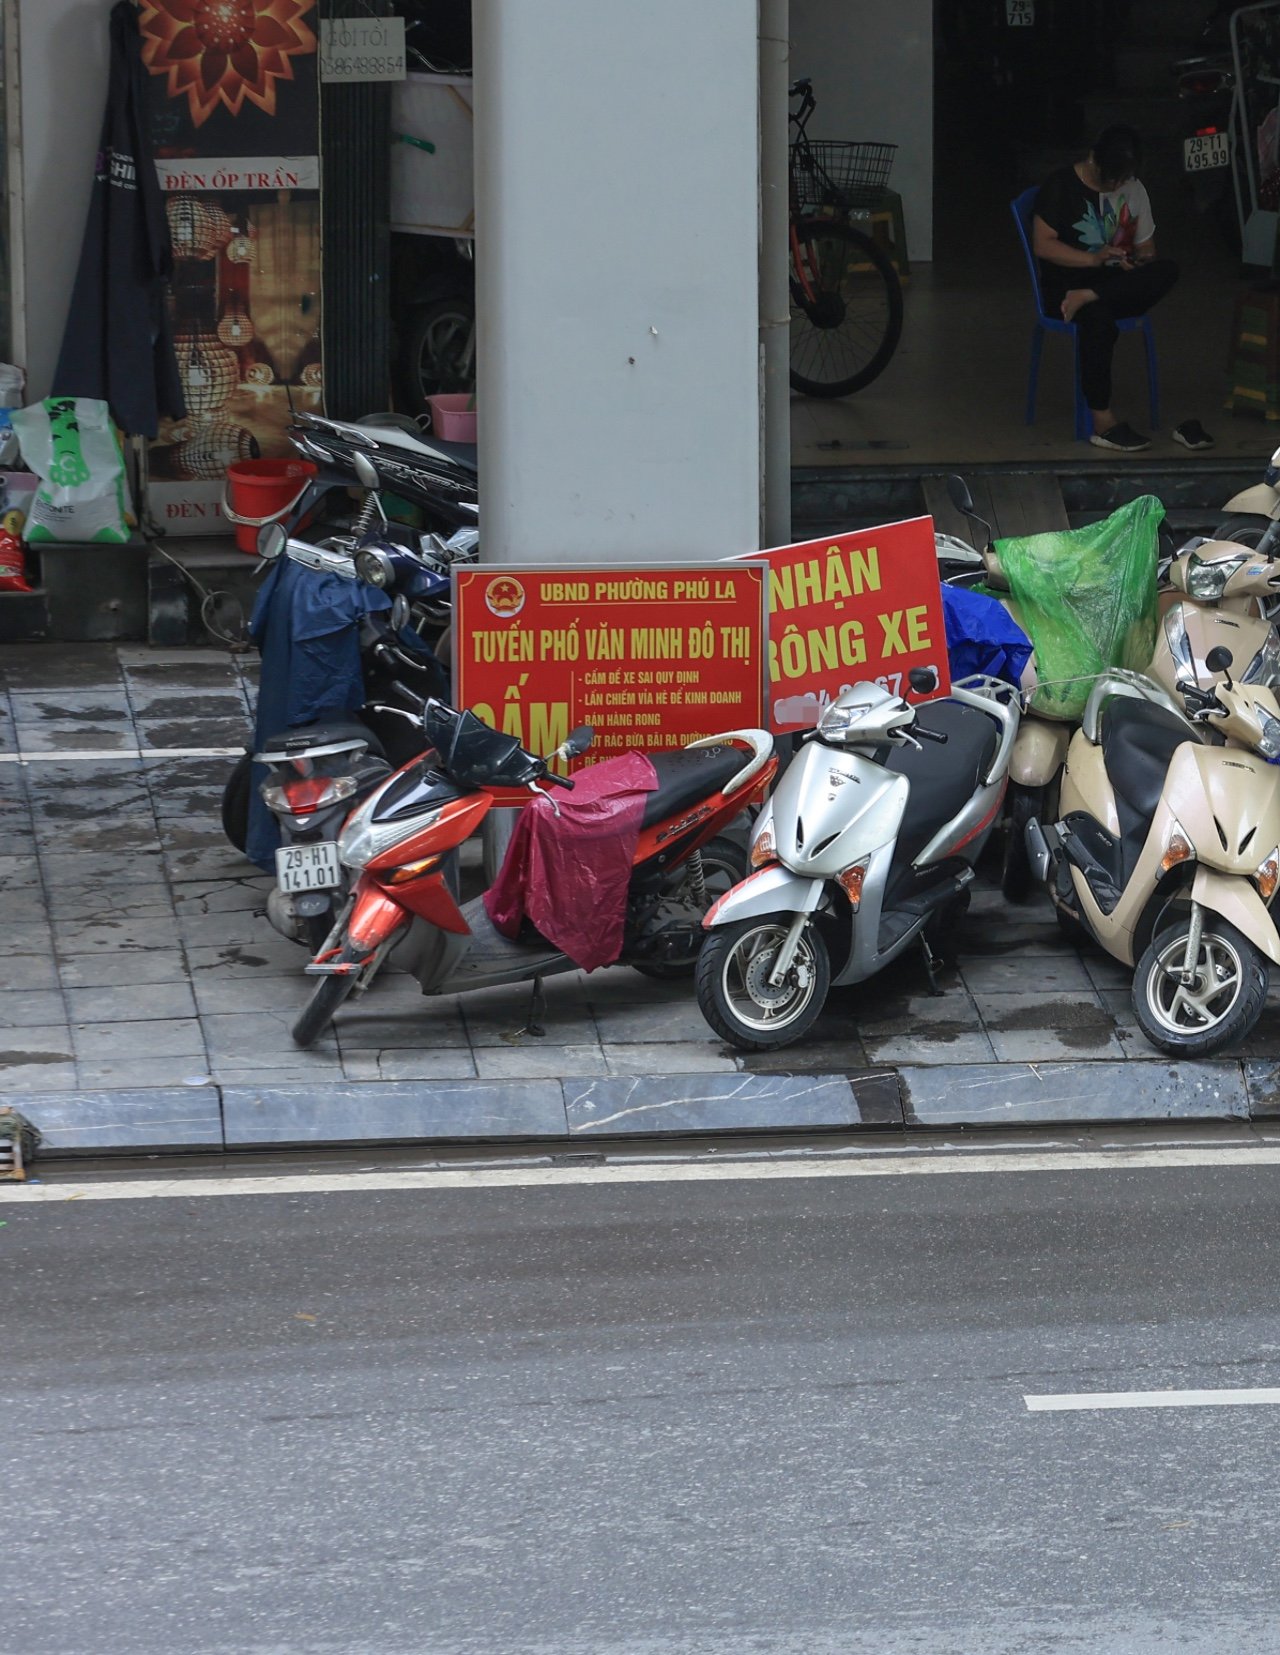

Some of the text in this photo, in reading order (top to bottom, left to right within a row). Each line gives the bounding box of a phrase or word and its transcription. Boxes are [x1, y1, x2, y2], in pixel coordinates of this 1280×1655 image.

[1190, 134, 1222, 153] 29-T1
[1187, 150, 1227, 169] 495.99
[165, 166, 299, 190] ĐÈN ỐP TRẦN
[166, 499, 208, 518] ĐÈN
[540, 577, 737, 602] UBND PHƯỜNG PHÚ LA
[769, 545, 881, 614] NHẬN
[472, 618, 751, 665] TUYẾN PHỐ VĂN MINH ĐÔ THỊ
[877, 605, 932, 658] XE
[585, 668, 607, 685] CẤM
[623, 672, 635, 685] XE
[638, 671, 654, 684] SAI
[656, 671, 674, 685] QUY
[676, 670, 700, 686] ĐỊNH
[585, 689, 603, 706] LẤN
[605, 688, 636, 706] CHIẾM
[656, 689, 668, 705] HÈ
[685, 691, 708, 704] KINH
[710, 691, 742, 704] DOANH
[585, 711, 661, 727] BÁN HÀNG RONG
[604, 732, 623, 748] RÁC
[647, 732, 663, 747] BÃI
[665, 734, 678, 747] RA
[286, 846, 329, 870] 29-H1
[283, 865, 335, 890] 141.01
